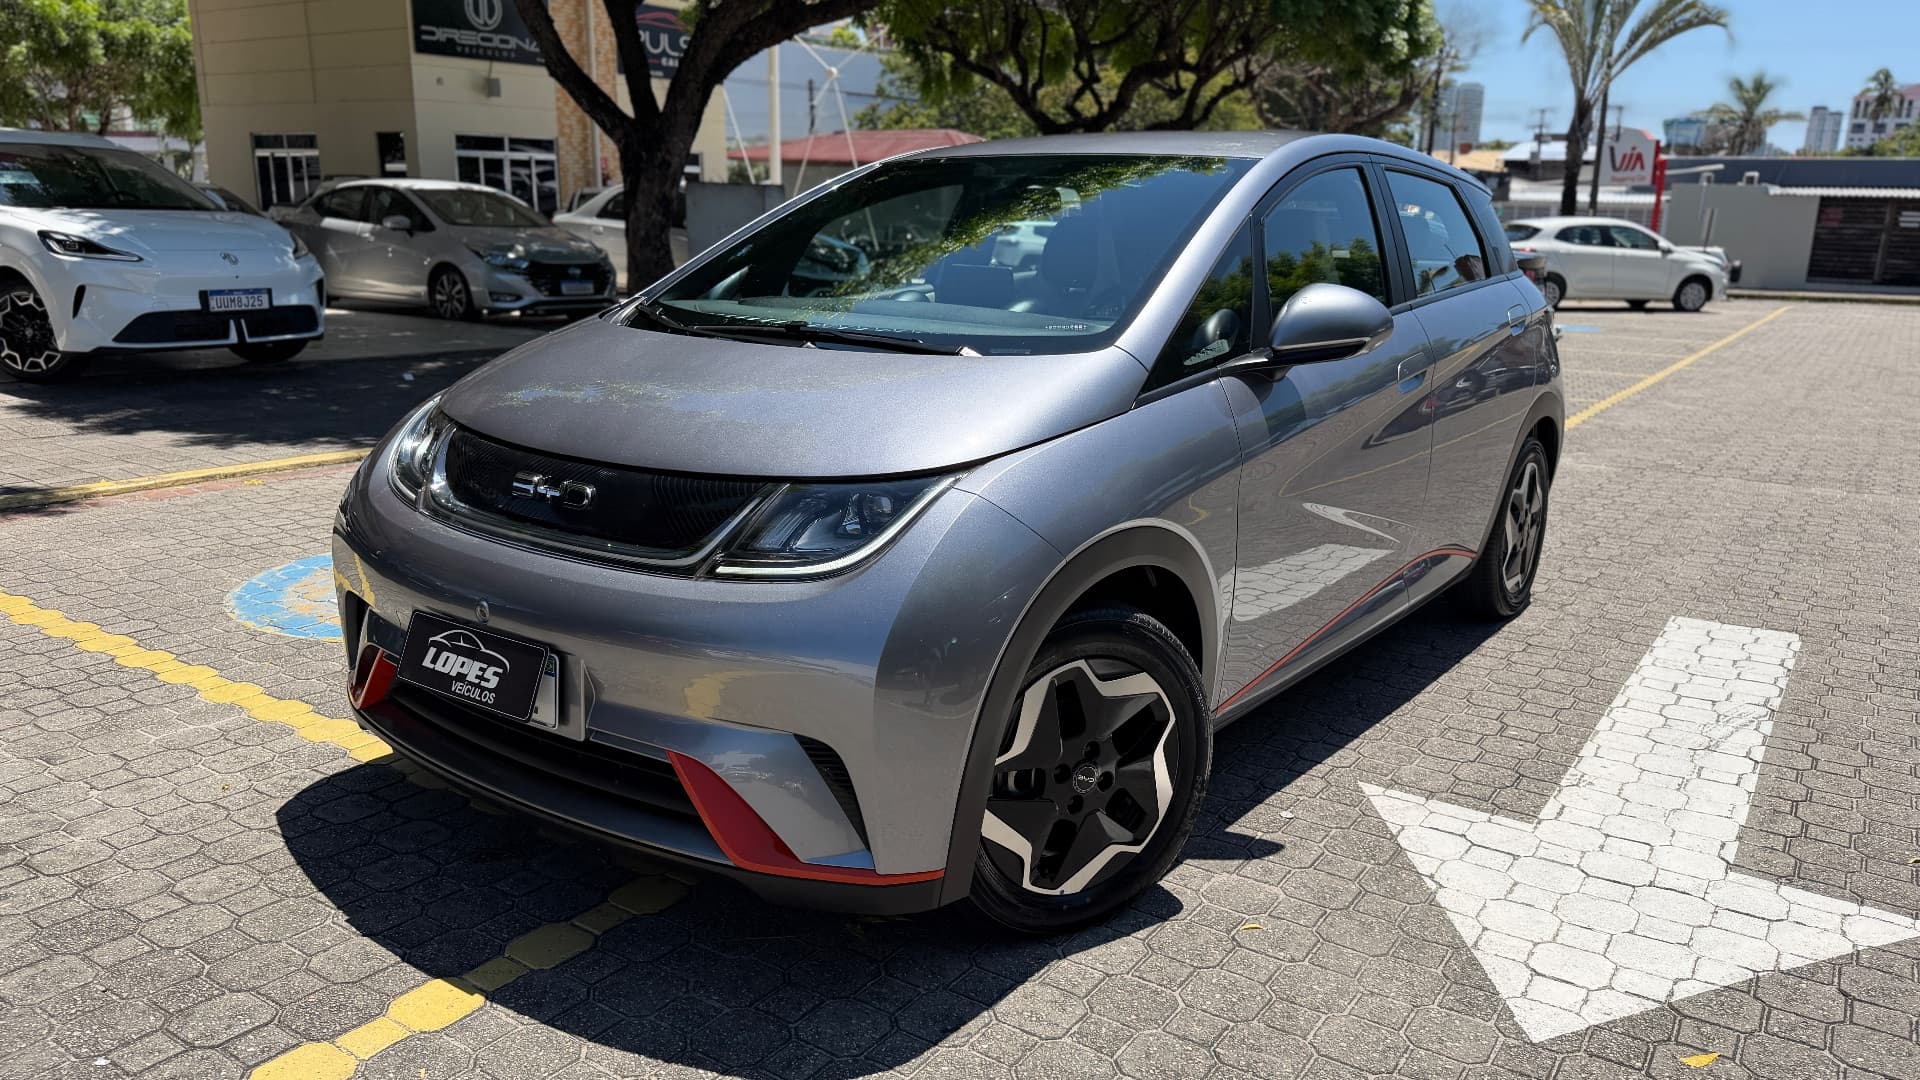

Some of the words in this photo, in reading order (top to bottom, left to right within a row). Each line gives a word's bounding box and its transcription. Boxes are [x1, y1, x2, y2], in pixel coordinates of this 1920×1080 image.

[215, 295, 264, 309] UUM8J25
[512, 471, 597, 510] BYD
[422, 647, 503, 689] LOPES
